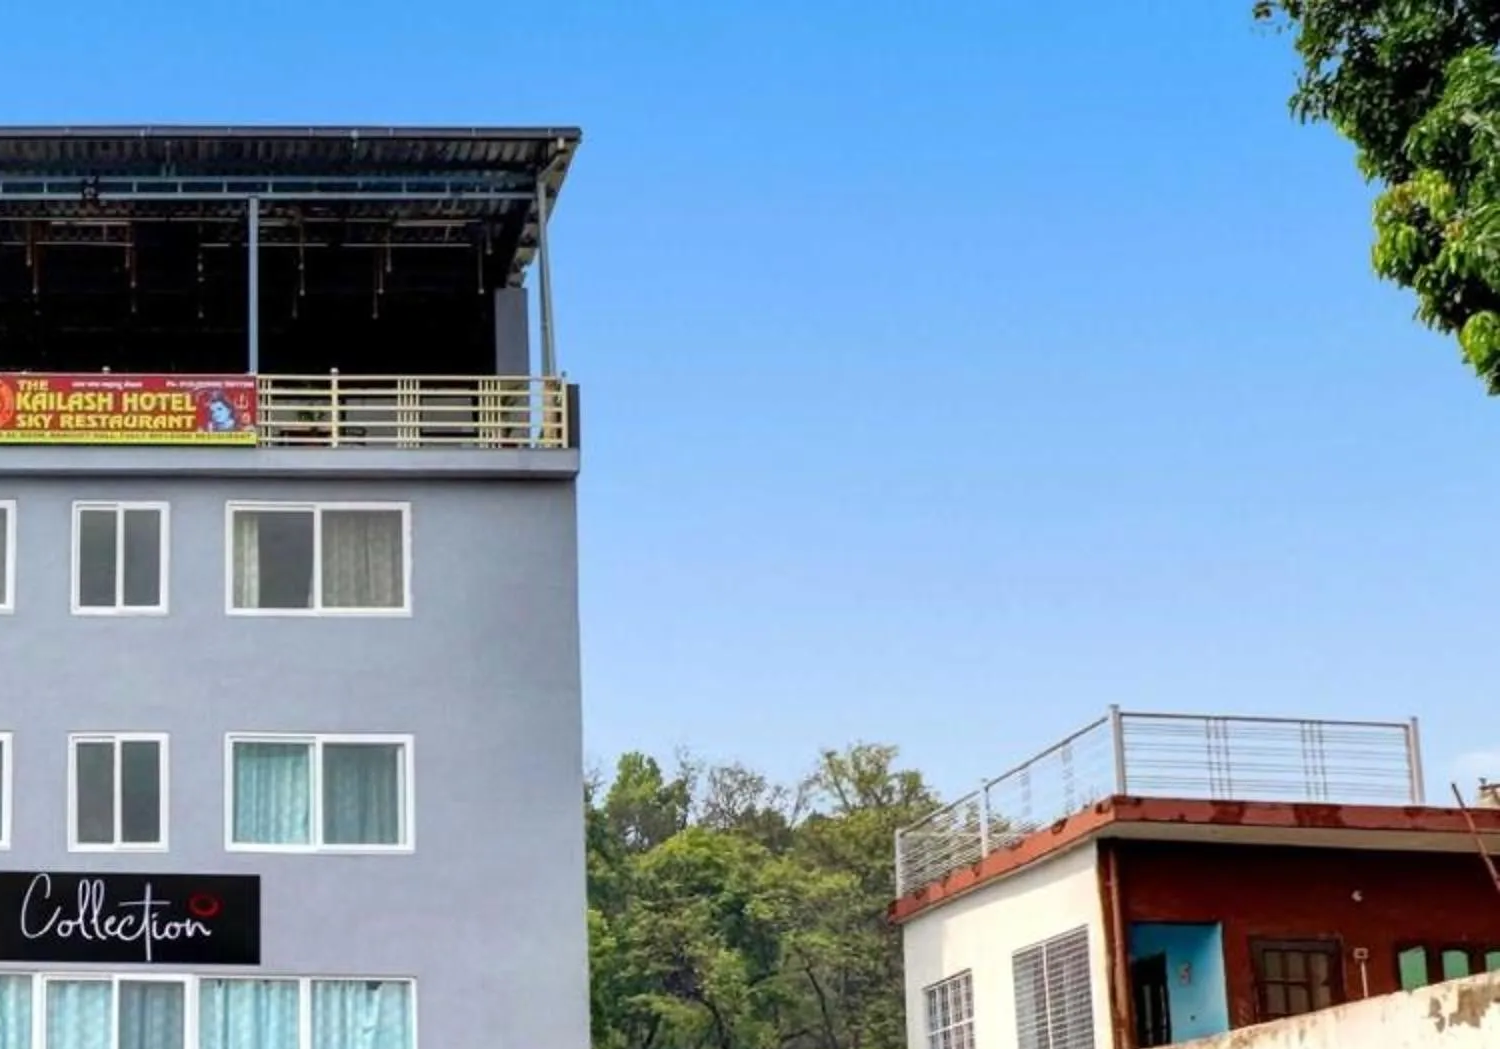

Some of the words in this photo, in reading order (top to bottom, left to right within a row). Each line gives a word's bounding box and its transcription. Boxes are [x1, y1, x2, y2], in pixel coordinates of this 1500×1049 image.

[16, 379, 48, 391] THE
[16, 391, 113, 412] KAILASH
[122, 391, 197, 412] HOTEL
[16, 413, 53, 430] SKY
[60, 413, 197, 430] RESTAURANT
[20, 872, 212, 961] Collection
